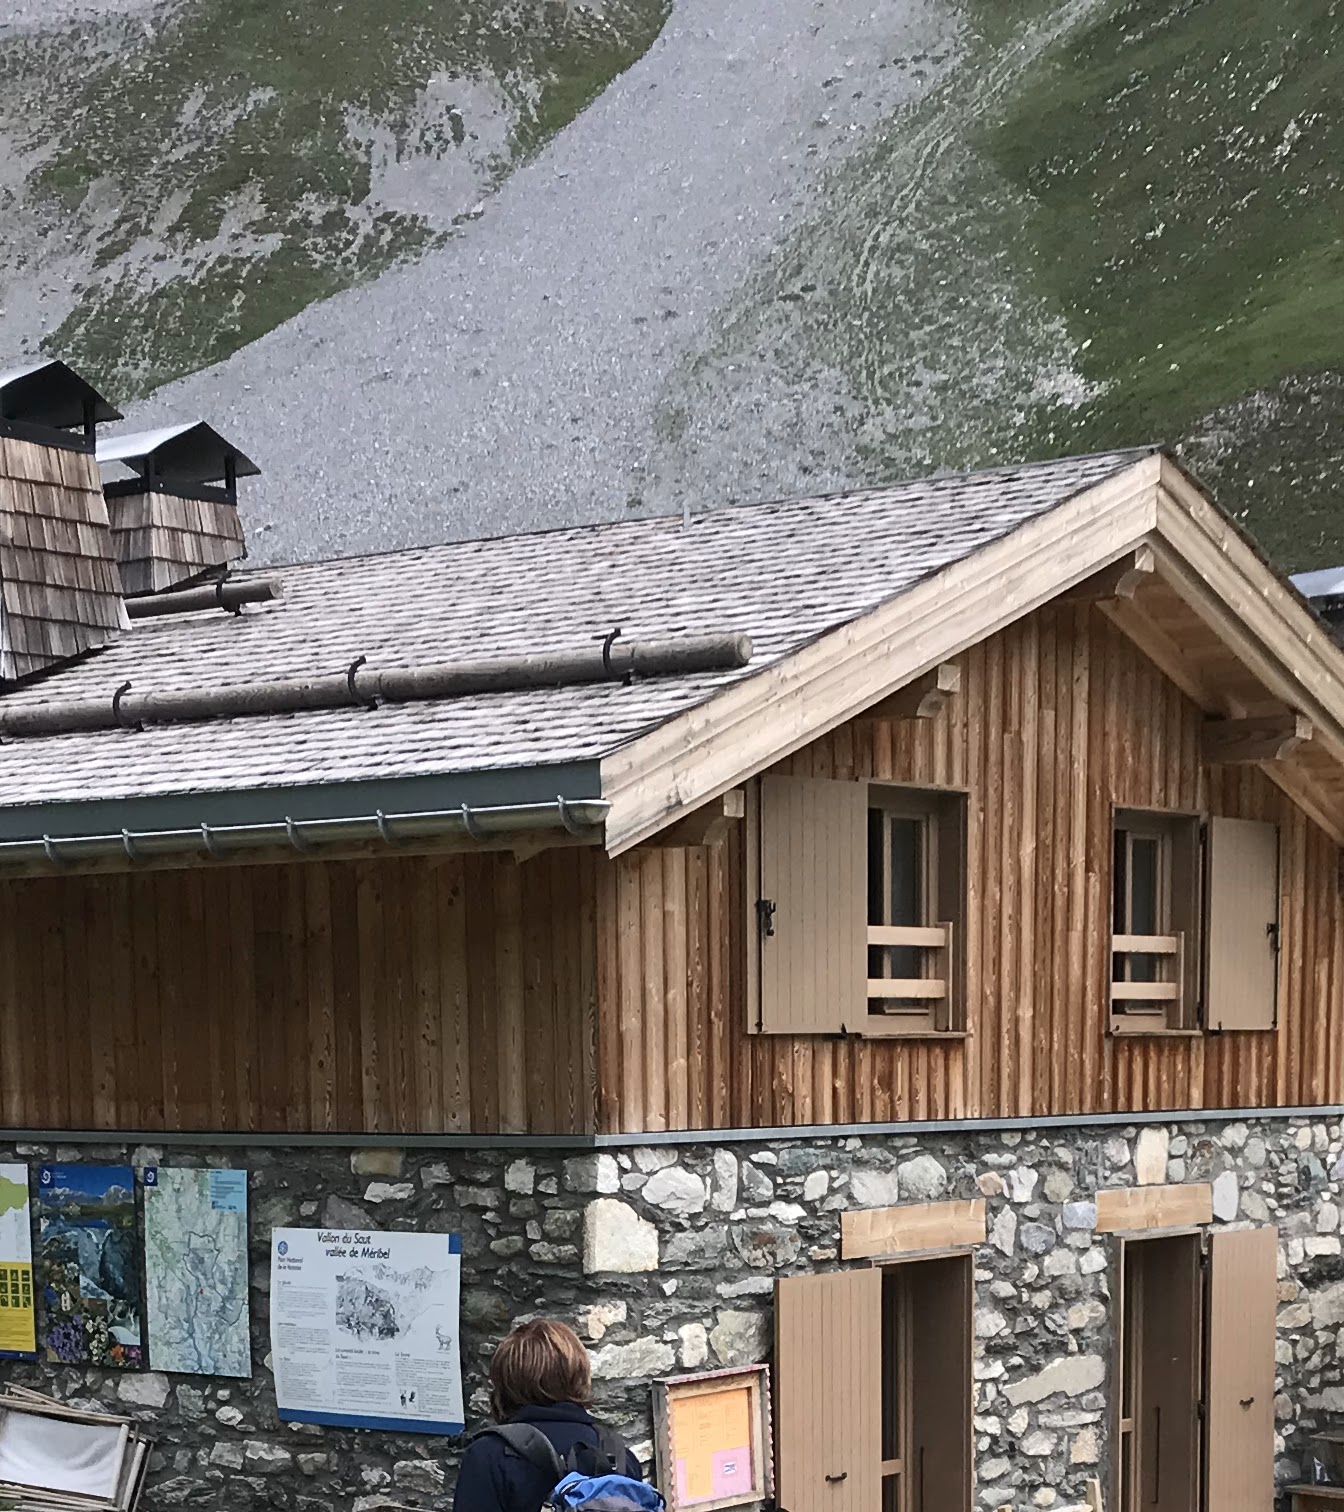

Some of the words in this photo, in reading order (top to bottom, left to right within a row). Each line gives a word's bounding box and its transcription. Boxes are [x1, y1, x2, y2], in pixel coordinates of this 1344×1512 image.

[317, 1231, 340, 1243] Vallon
[342, 1232, 352, 1244] du
[354, 1232, 371, 1244] Saut
[349, 1246, 359, 1258] de
[361, 1247, 391, 1259] Méribel
